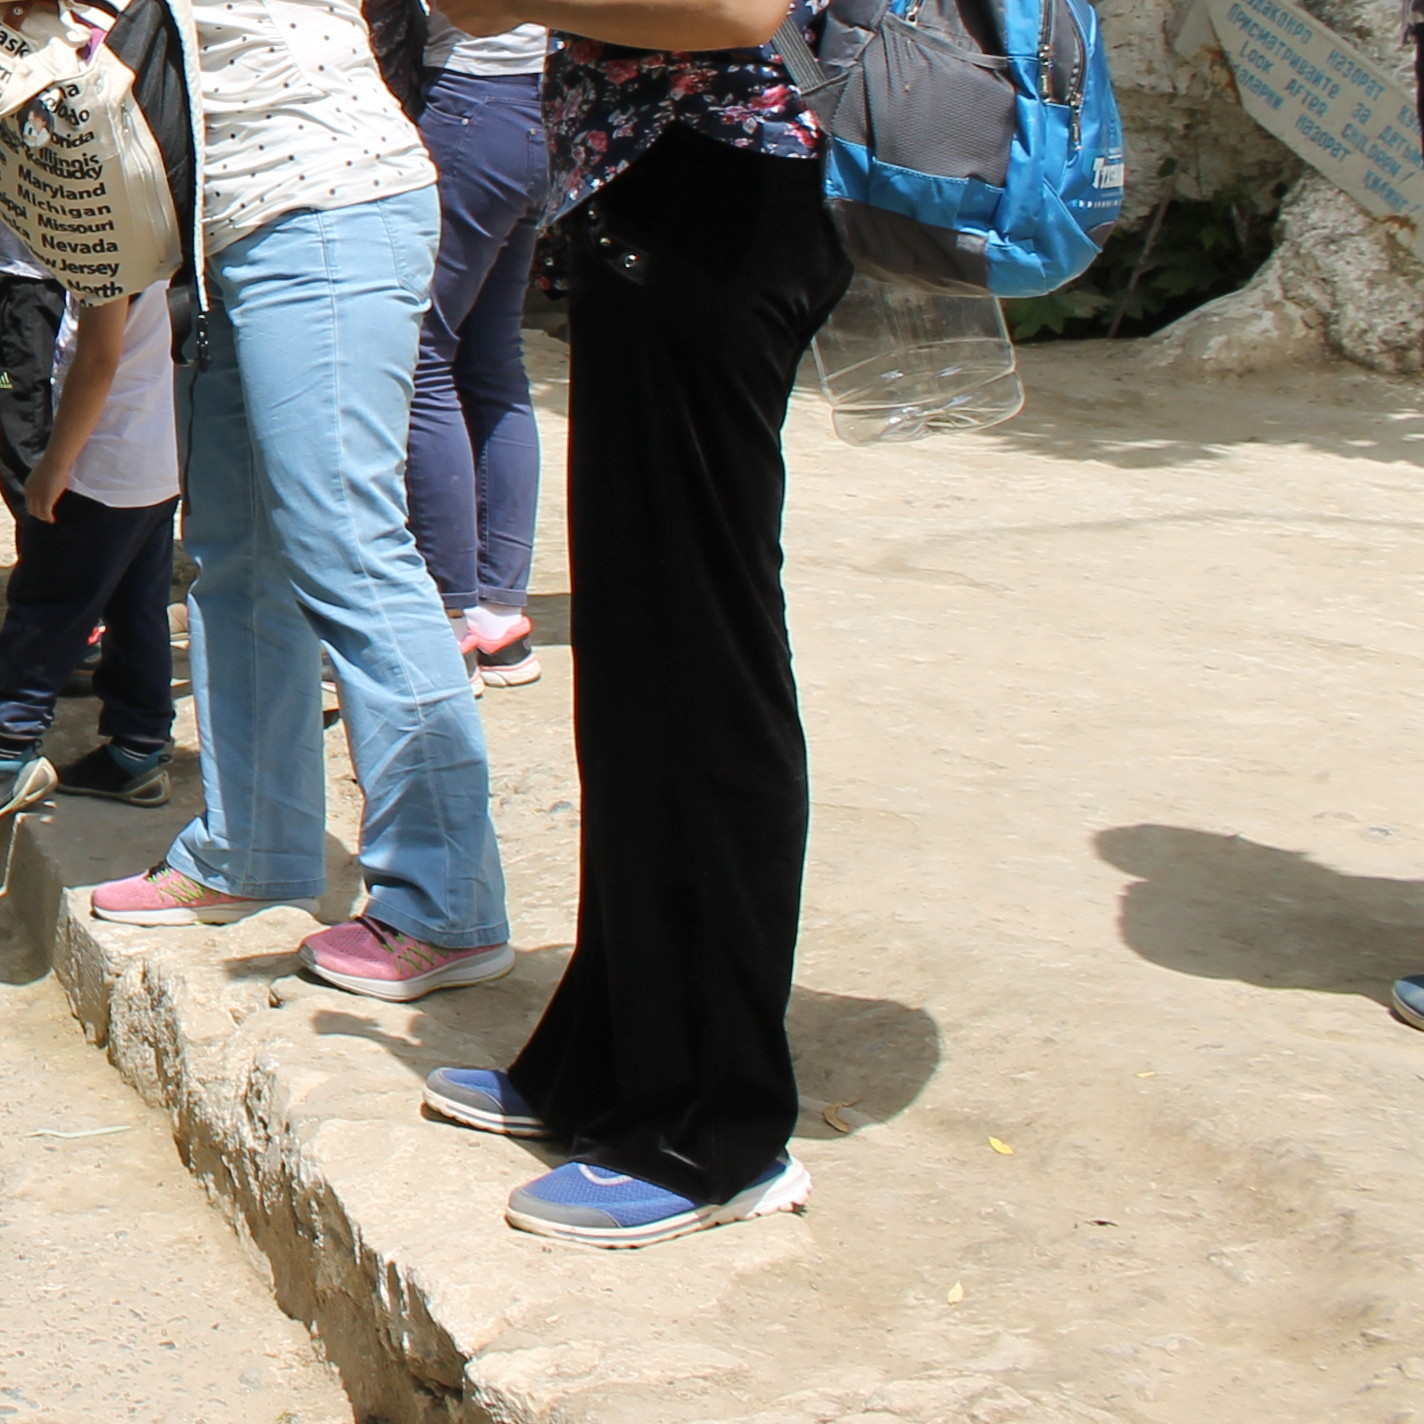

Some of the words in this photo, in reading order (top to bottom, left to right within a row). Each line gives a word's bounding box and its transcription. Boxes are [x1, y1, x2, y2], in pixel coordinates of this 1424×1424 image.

[51, 130, 95, 149] orida
[17, 163, 107, 201] Maryland
[17, 183, 112, 219] Michigan
[37, 213, 115, 234] Missouri
[41, 233, 119, 255] Nevada
[59, 258, 120, 277] Jersey
[66, 279, 124, 299] North
